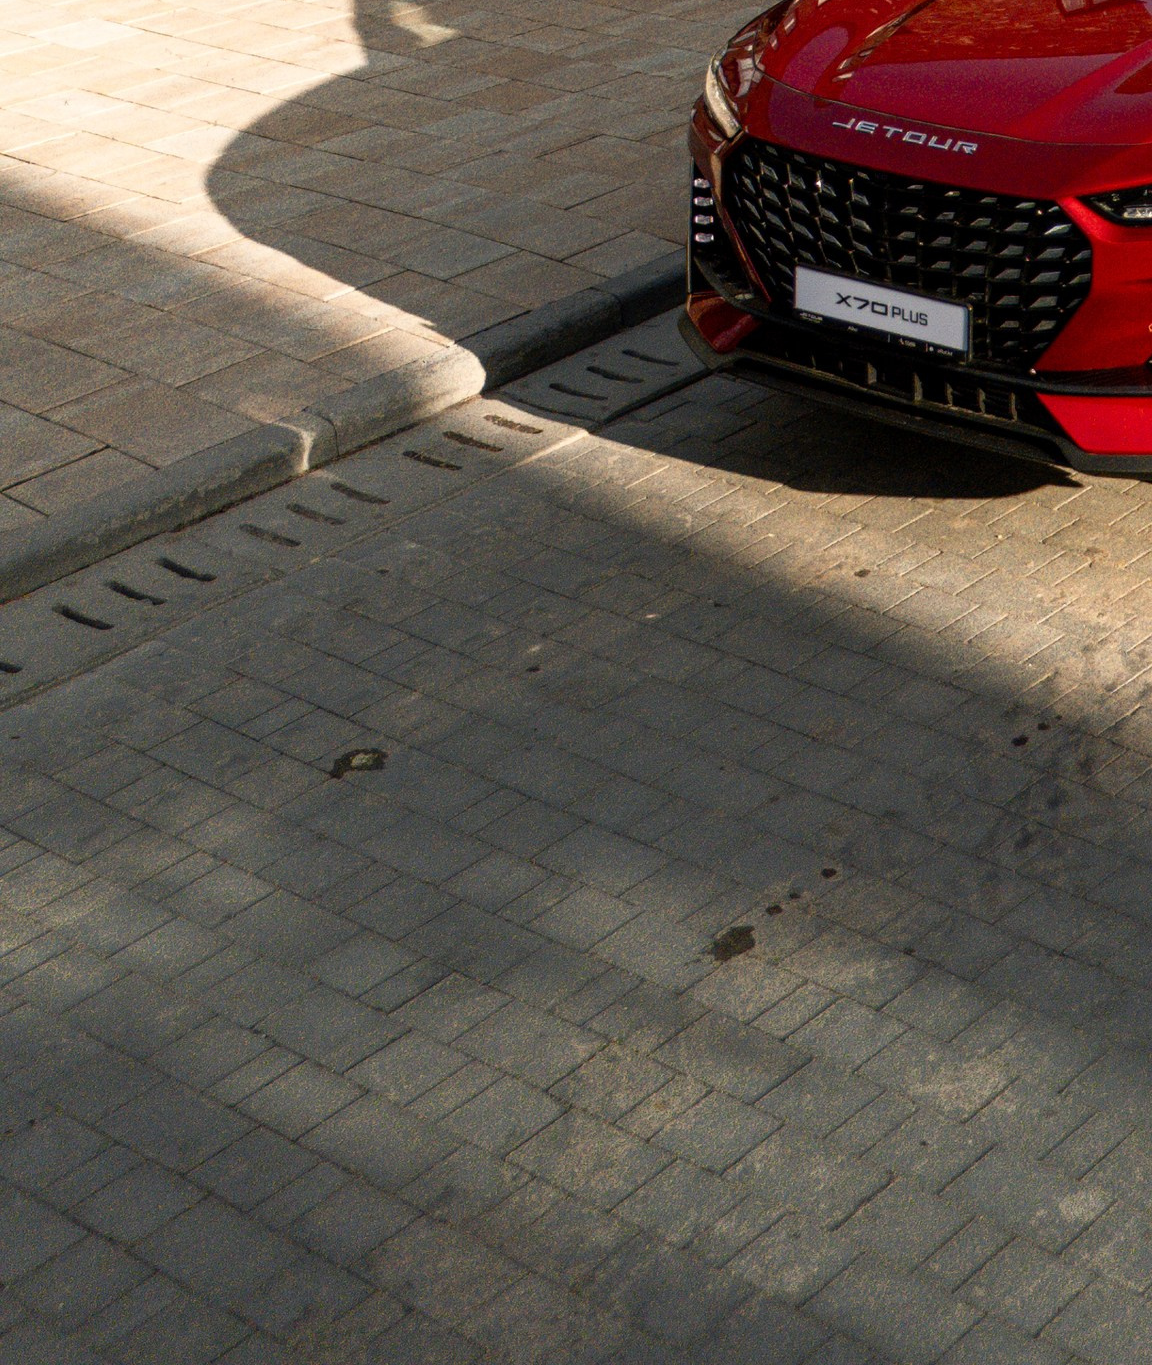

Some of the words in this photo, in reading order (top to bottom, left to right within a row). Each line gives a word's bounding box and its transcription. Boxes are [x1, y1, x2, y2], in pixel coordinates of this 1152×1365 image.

[832, 118, 978, 155] JETOUR
[836, 292, 888, 316] X70
[891, 306, 928, 326] PLUS
